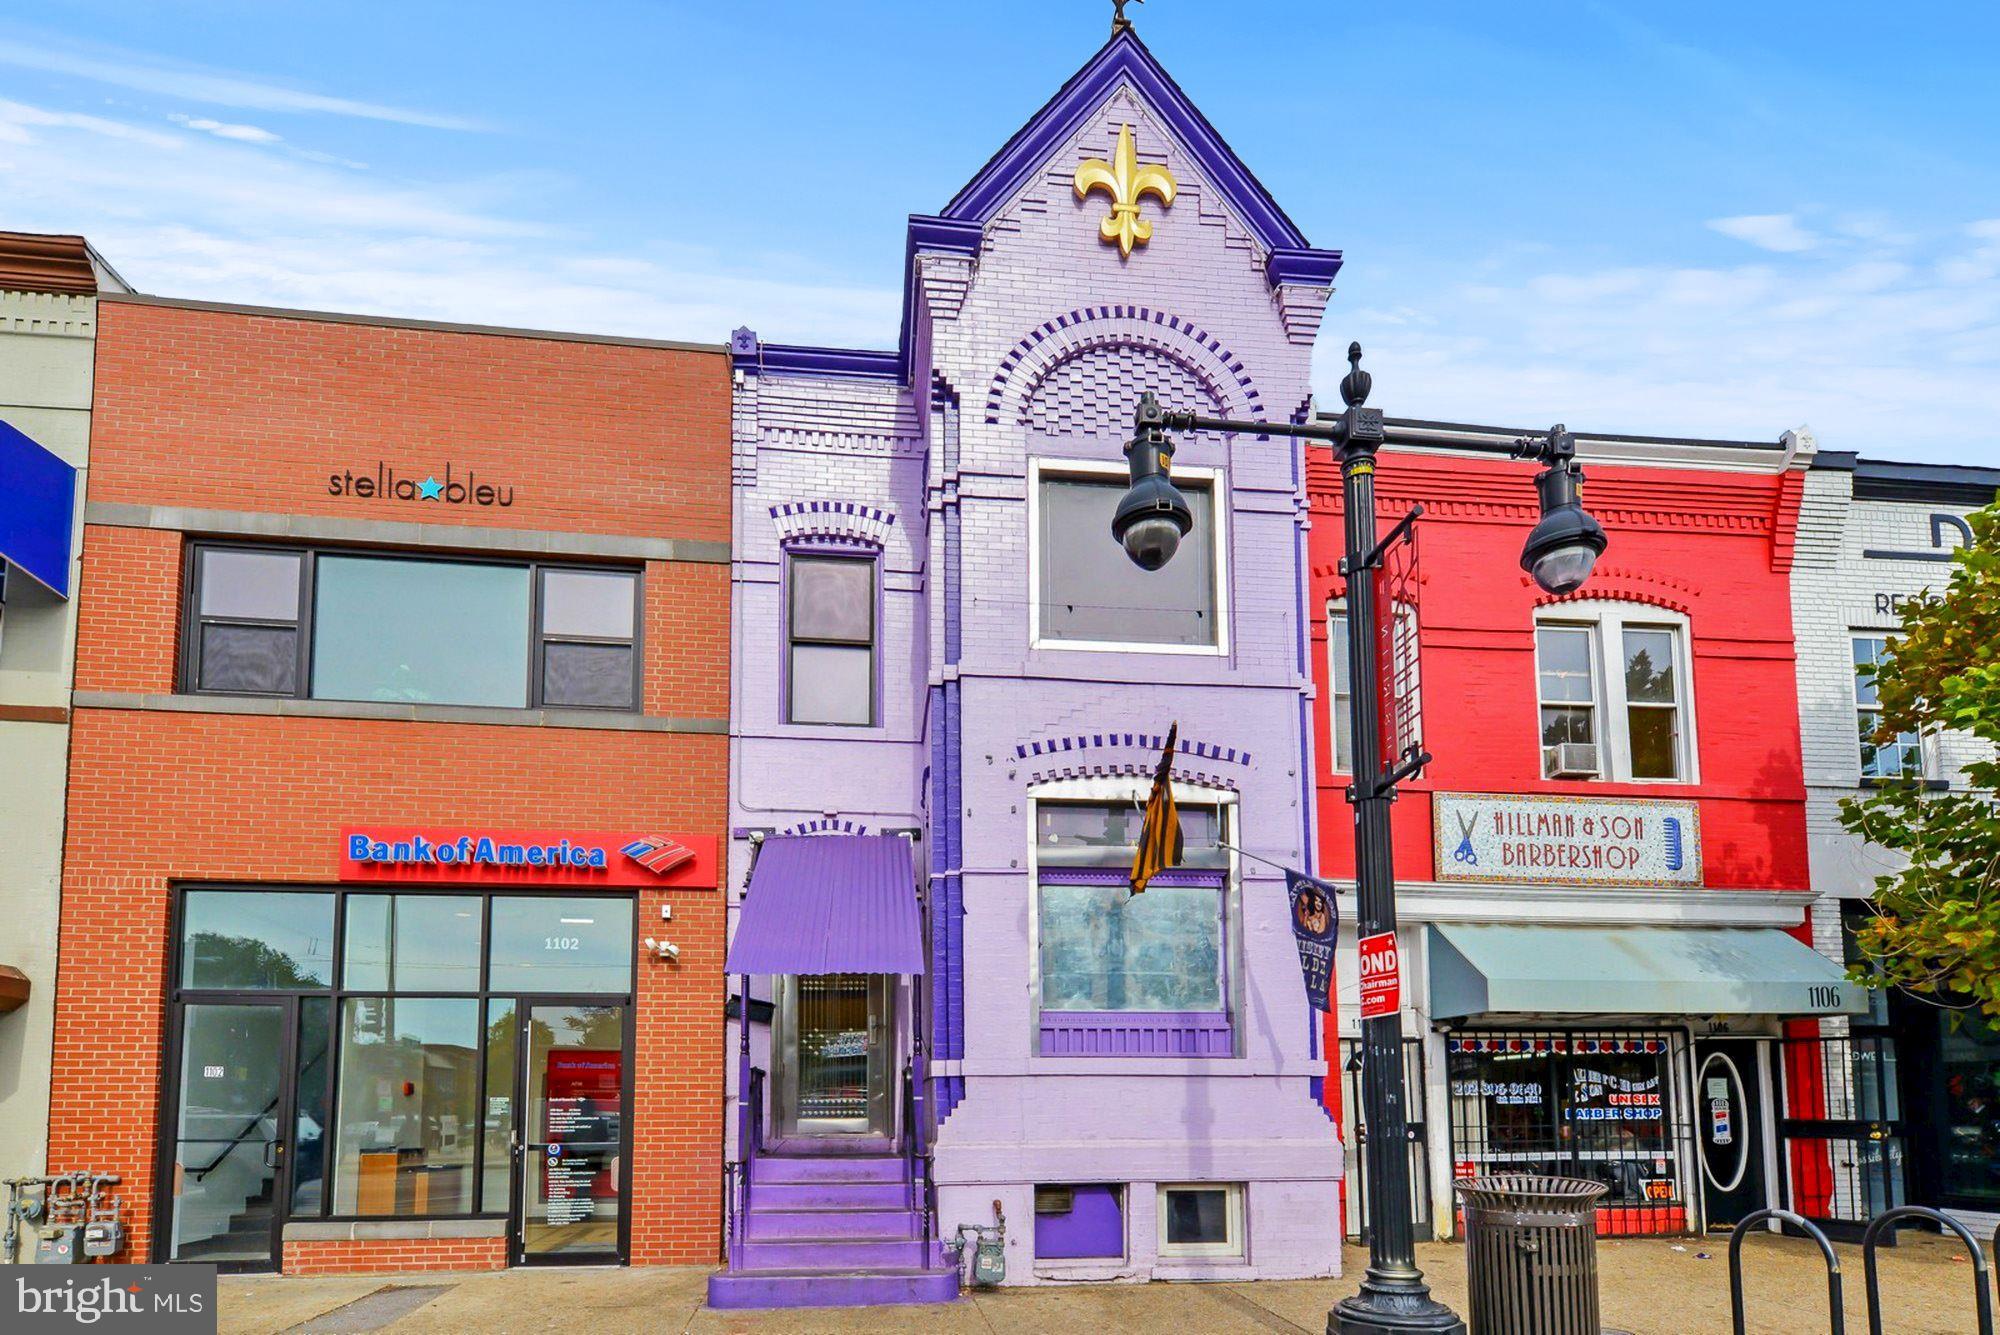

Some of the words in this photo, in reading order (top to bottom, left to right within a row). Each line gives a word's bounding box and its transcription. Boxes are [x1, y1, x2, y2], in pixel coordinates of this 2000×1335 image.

[328, 460, 416, 500] stella
[446, 461, 513, 507] bleu
[1493, 811, 1575, 837] HILLMAN
[1582, 817, 1595, 836] &
[1601, 815, 1644, 840] SON
[349, 834, 435, 864] Bank
[437, 836, 474, 865] of
[474, 837, 607, 868] America
[1502, 842, 1640, 870] BARBERSHOP
[544, 937, 580, 950] 1102
[1807, 986, 1841, 1008] 1106
[1623, 1107, 1663, 1120] SHOP
